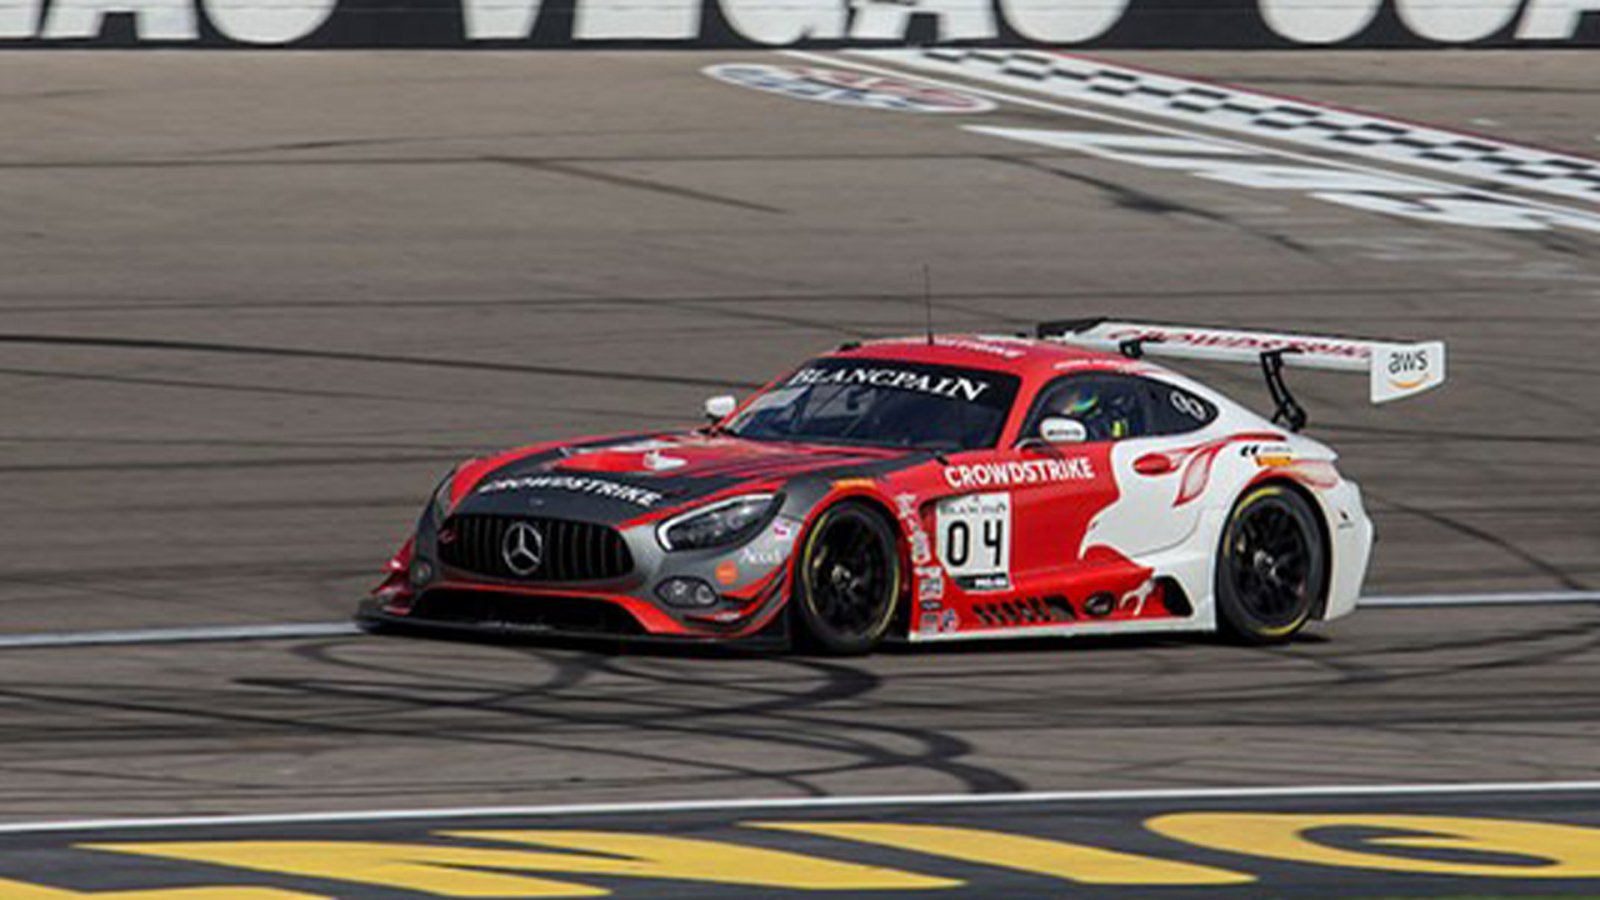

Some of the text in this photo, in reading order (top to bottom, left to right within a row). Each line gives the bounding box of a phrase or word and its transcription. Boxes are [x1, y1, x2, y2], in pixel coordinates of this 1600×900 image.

[1388, 349, 1428, 374] aws
[787, 366, 989, 402] BLANCPAIN
[944, 456, 1096, 489] CROWDSTRIKE
[946, 519, 1003, 567] 04
